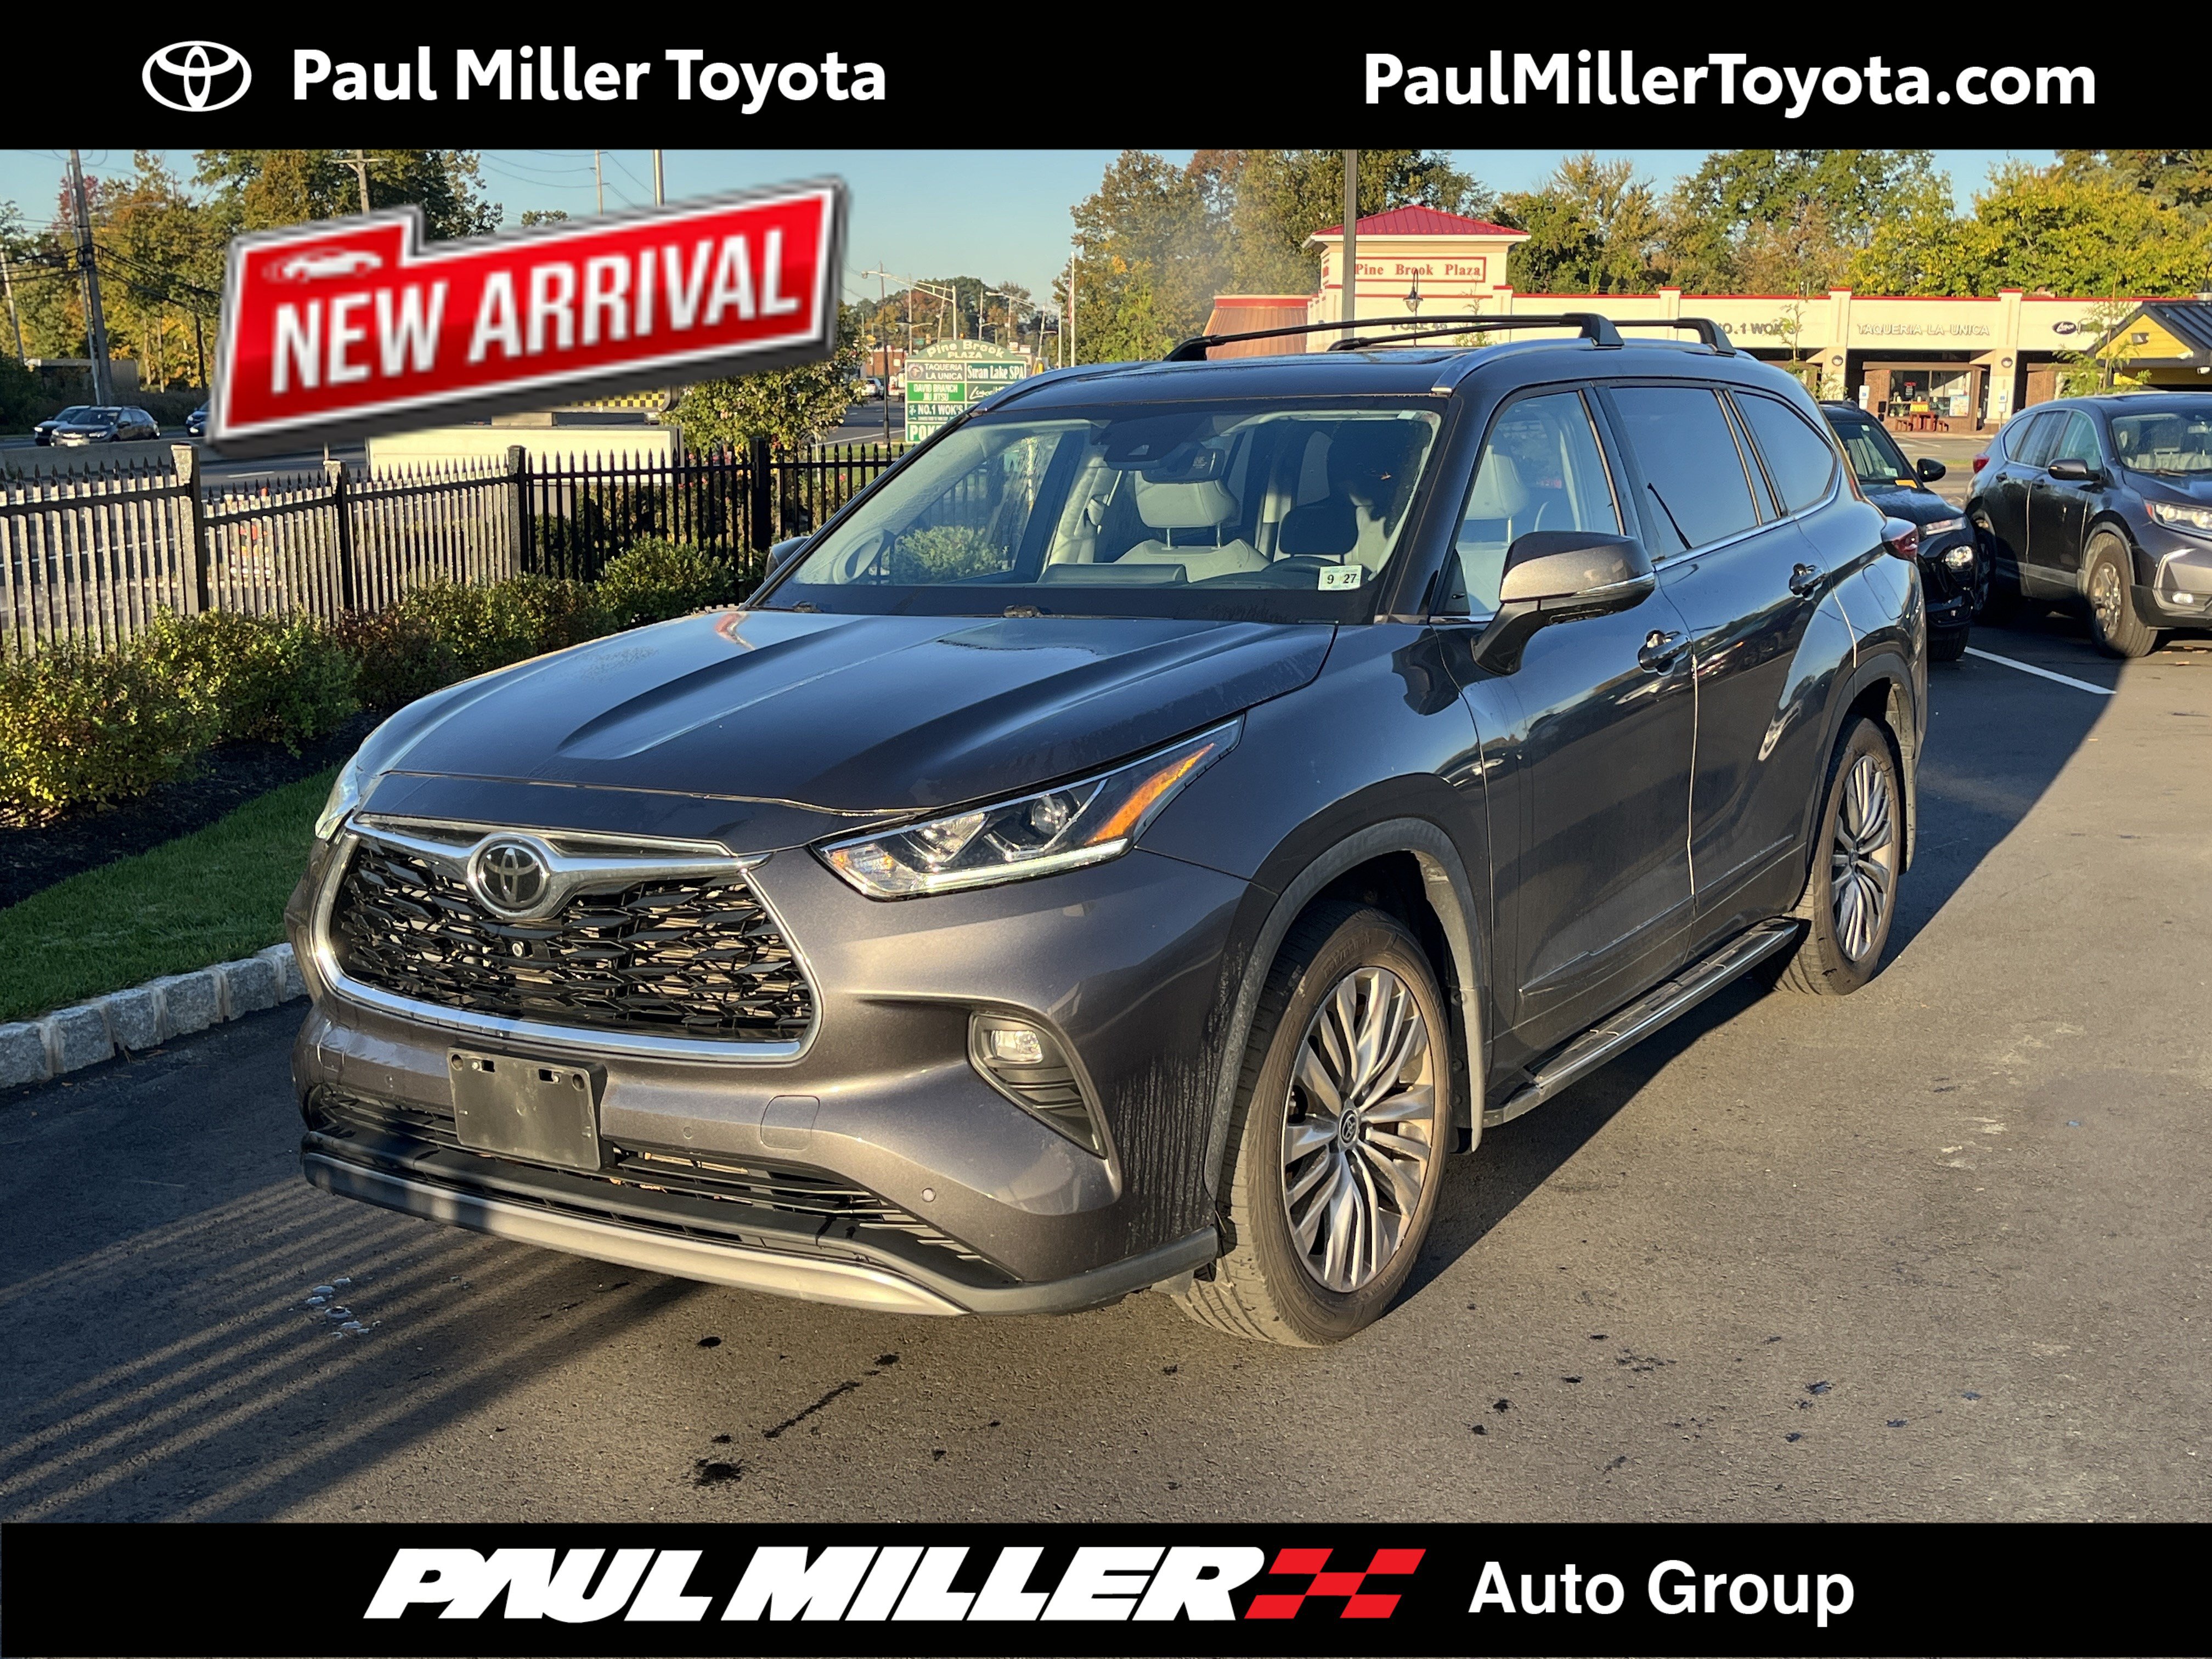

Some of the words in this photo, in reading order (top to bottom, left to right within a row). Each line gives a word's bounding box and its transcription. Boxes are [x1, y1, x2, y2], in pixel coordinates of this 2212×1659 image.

[1355, 263, 1384, 275] Pine
[1395, 263, 1434, 275] Brook
[1444, 263, 1481, 276] Plaza
[1857, 323, 1922, 336] TAQUERIA
[1927, 323, 1945, 336] LA
[1950, 323, 1990, 336] UNICA
[926, 342, 958, 358] Pine
[962, 340, 1005, 358] Brook
[990, 365, 1008, 379] Lake
[1009, 365, 1024, 380] SPA
[913, 383, 932, 393] DAVID
[933, 383, 958, 393] BRANCH
[917, 404, 936, 415] NO.1
[1327, 574, 1334, 584] 9
[1342, 573, 1357, 584] 27
